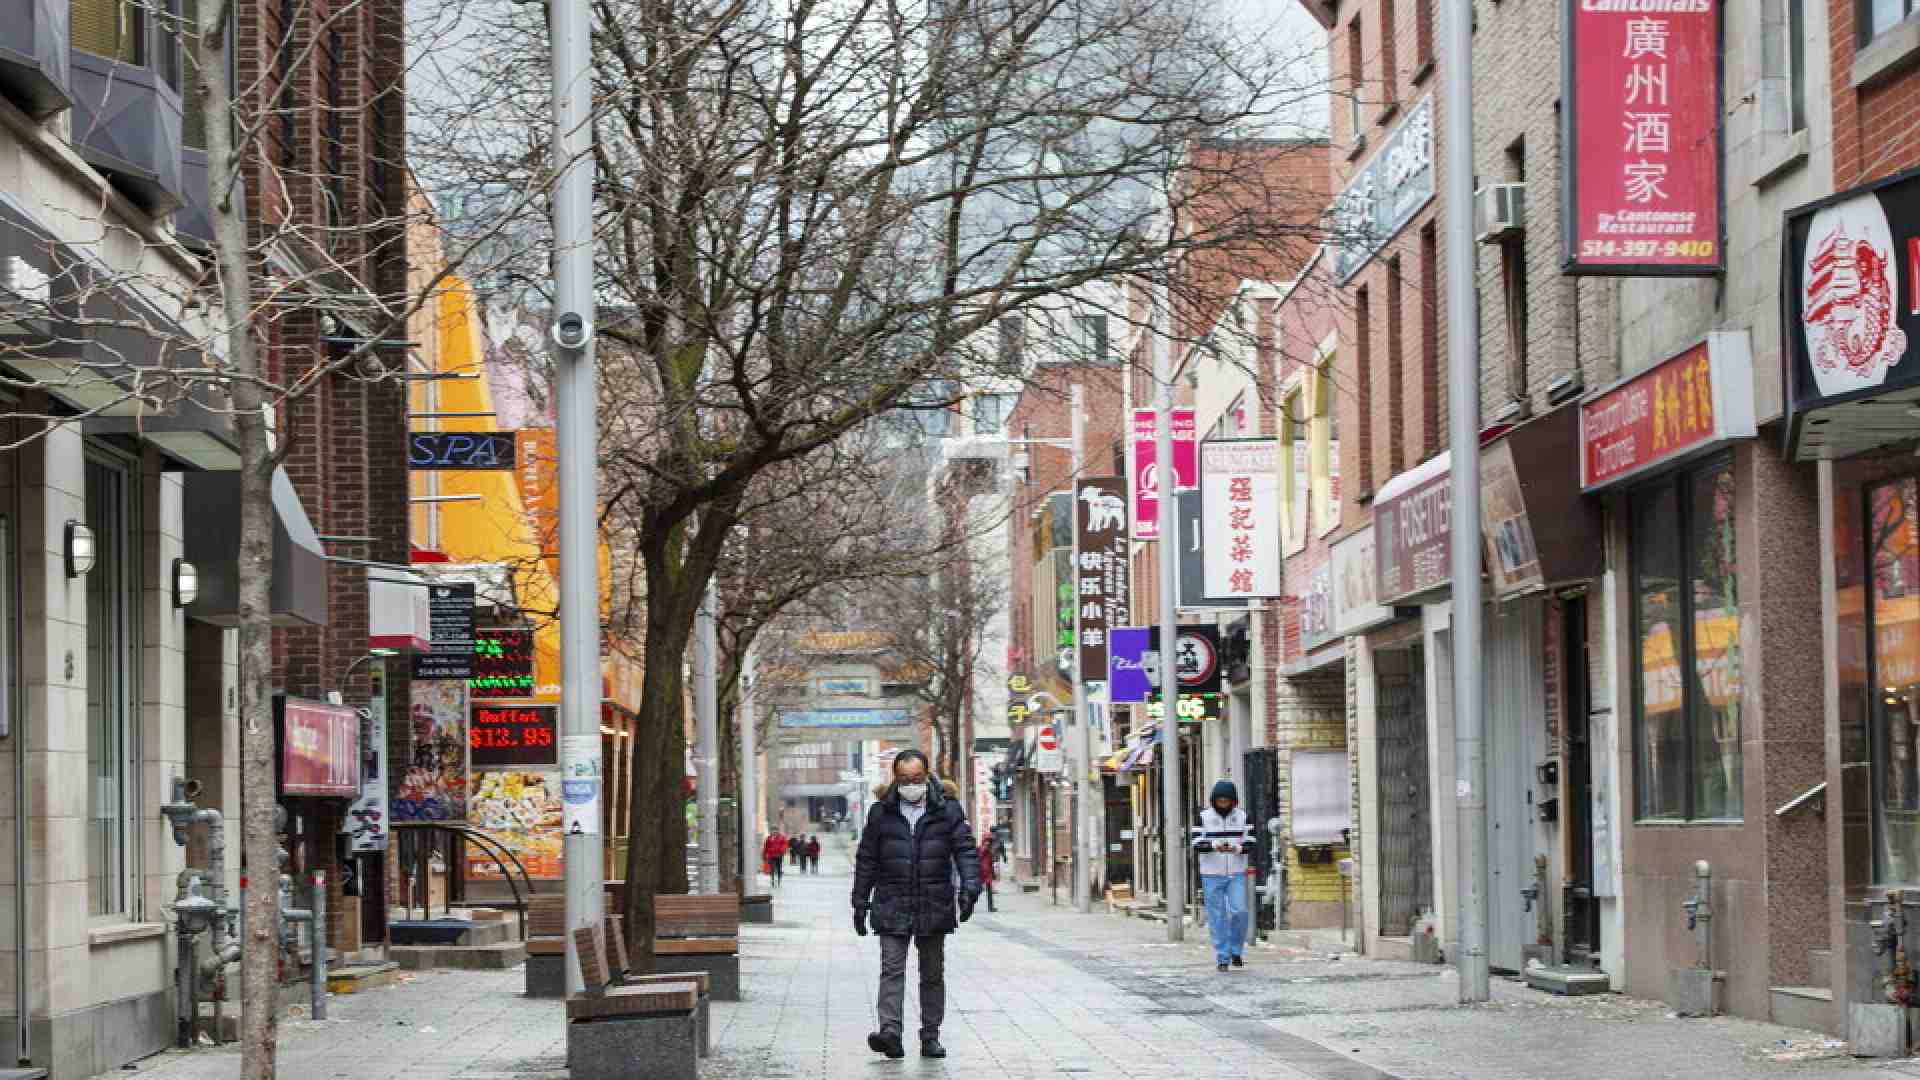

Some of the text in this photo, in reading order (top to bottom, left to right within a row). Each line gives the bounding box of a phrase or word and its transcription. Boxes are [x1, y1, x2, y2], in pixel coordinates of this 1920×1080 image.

[1623, 16, 1672, 202] 廣州酒家
[1616, 209, 1697, 222] Cantonese
[1597, 221, 1696, 234] Restaurant
[1581, 240, 1713, 257] 514-397-9410
[408, 435, 499, 466] SPA
